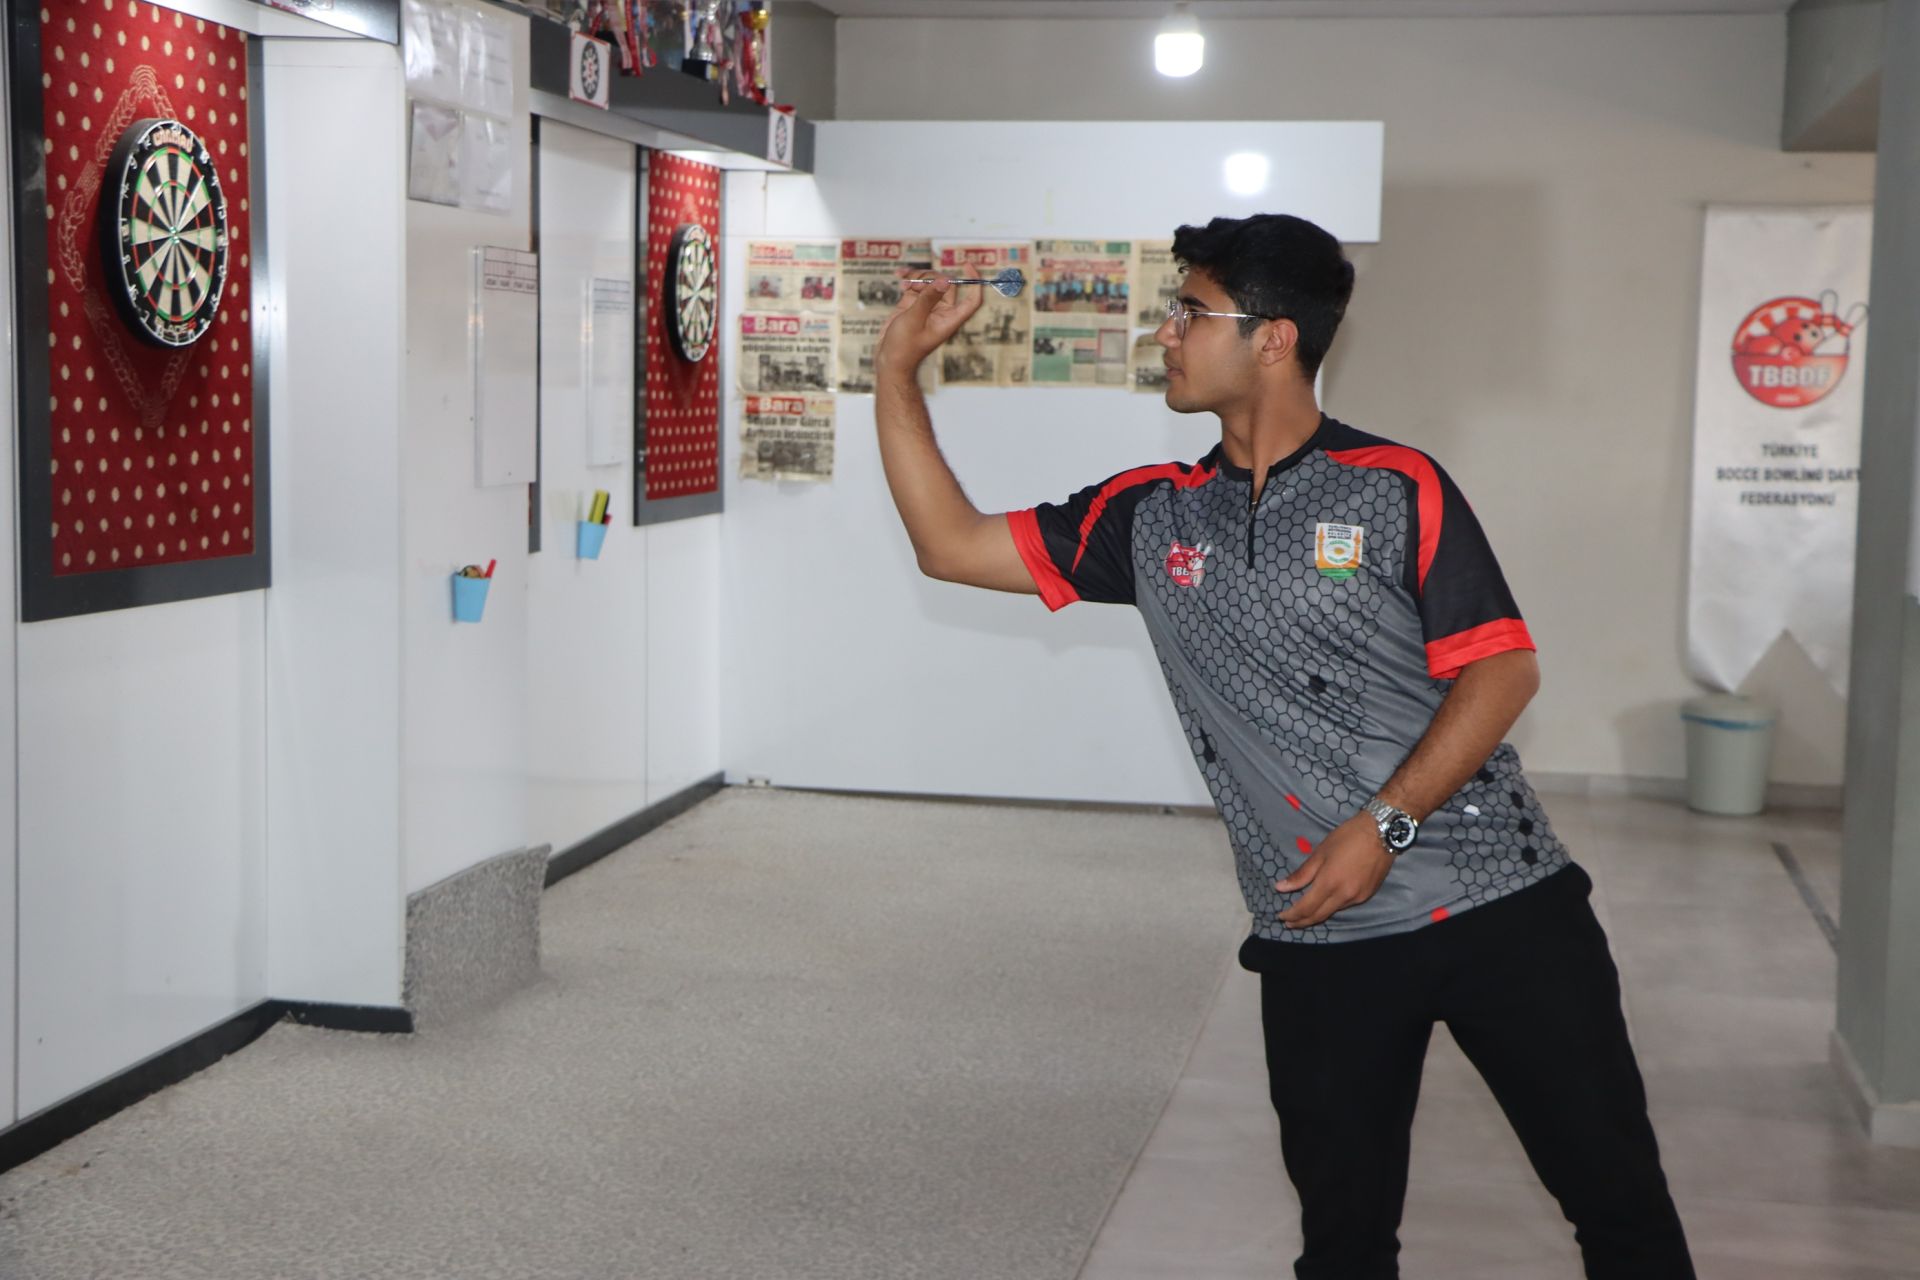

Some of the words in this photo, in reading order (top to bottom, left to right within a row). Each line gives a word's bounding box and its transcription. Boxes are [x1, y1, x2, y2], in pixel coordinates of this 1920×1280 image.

[755, 317, 798, 333] Bara
[1748, 365, 1832, 388] TBBDF
[1716, 467, 1758, 481] BOCCE
[1741, 492, 1836, 506] FEDERASYONU
